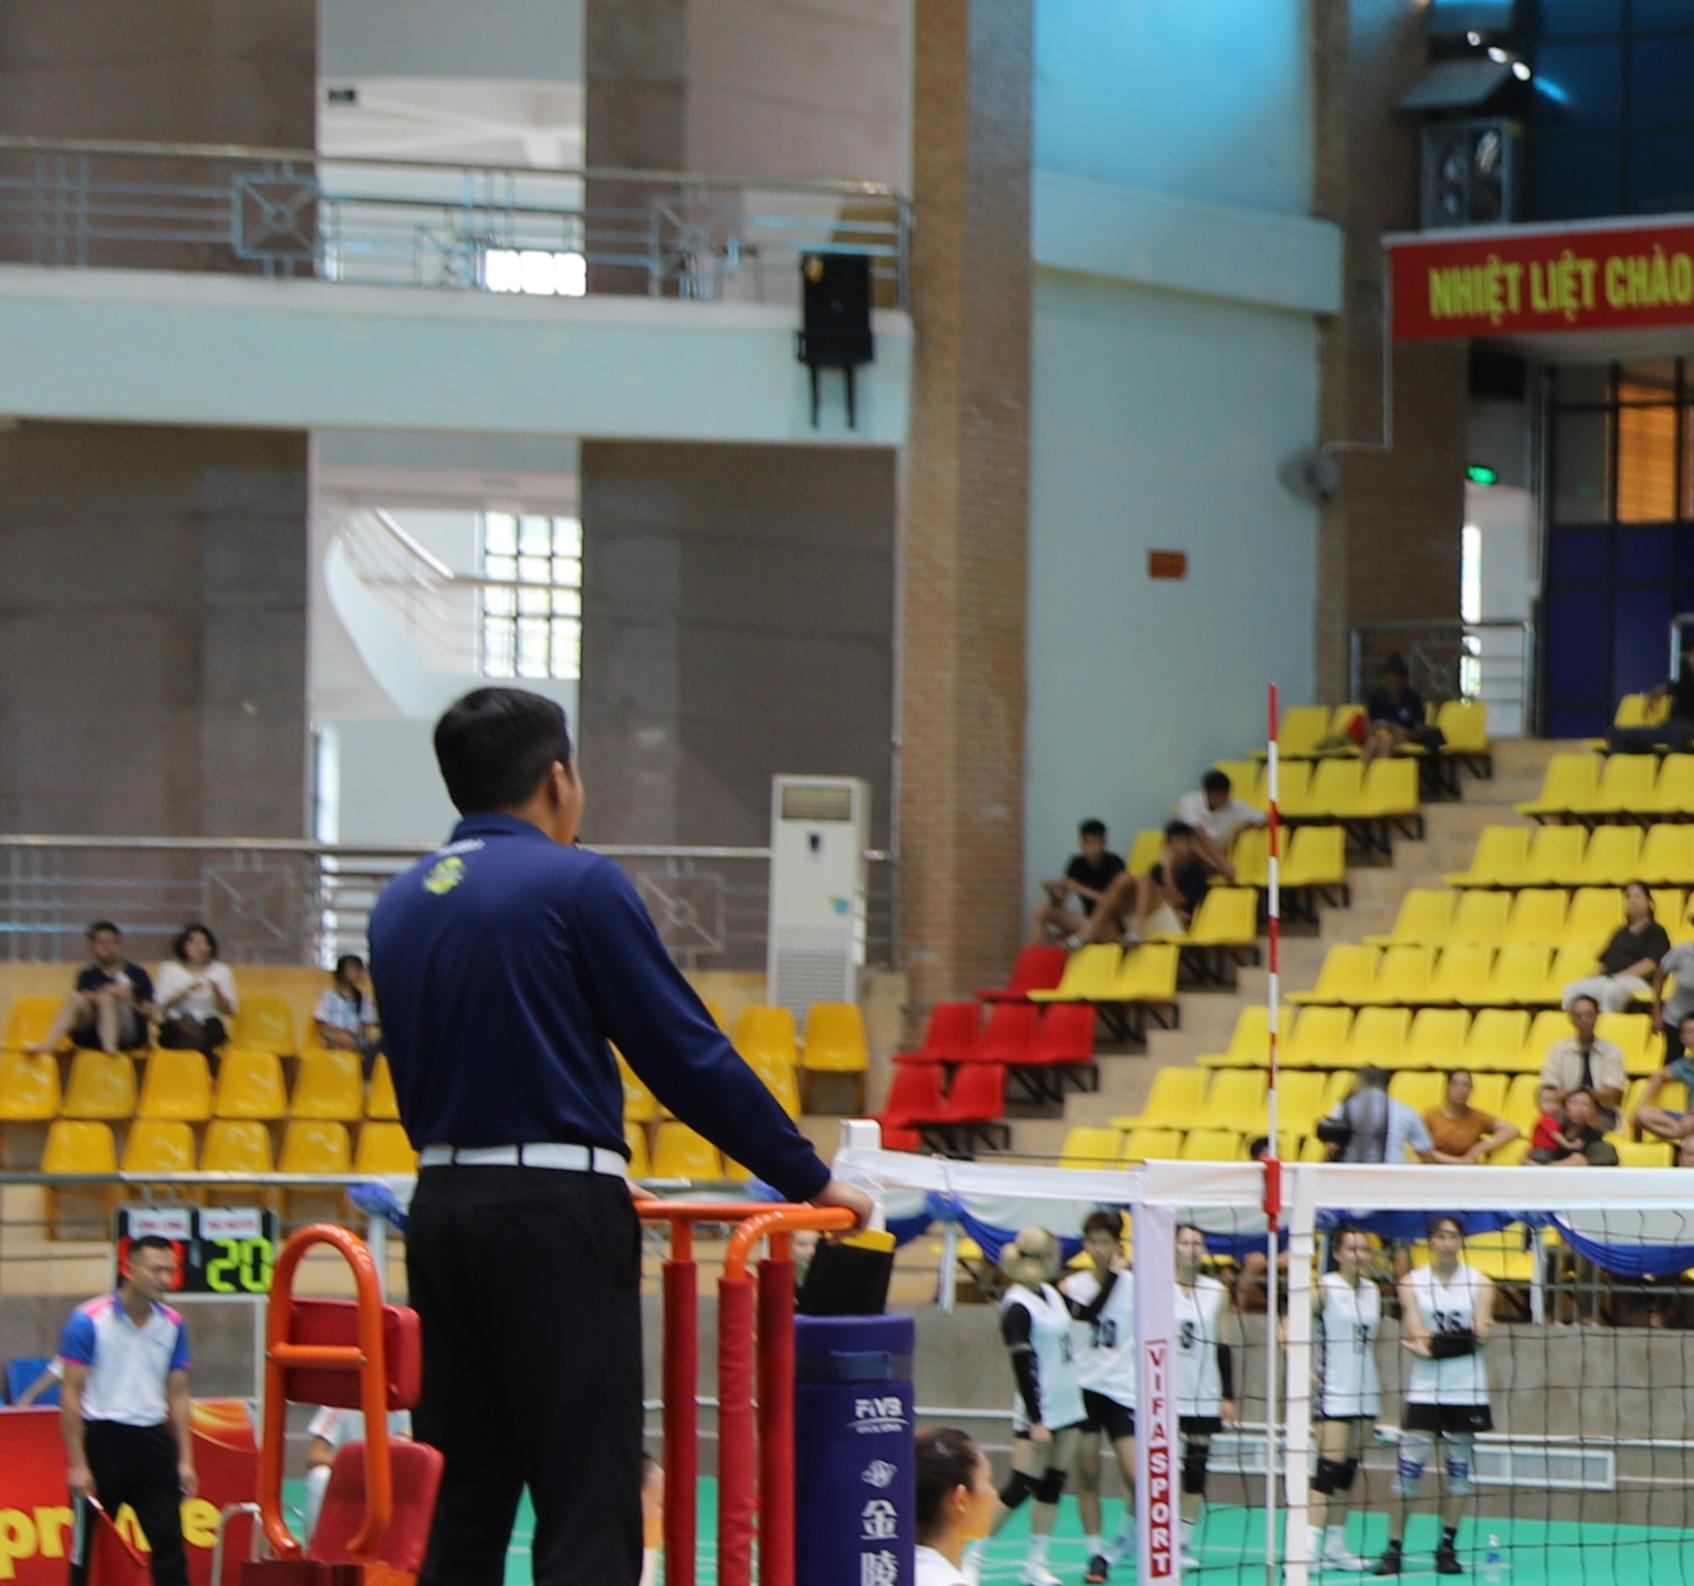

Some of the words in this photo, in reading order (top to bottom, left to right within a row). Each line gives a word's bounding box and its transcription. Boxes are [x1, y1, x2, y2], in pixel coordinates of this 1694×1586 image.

[1429, 253, 1522, 327] NHIỆT
[1531, 251, 1596, 322] LIỆT
[1605, 245, 1694, 307] CHÀO
[206, 1237, 275, 1293] 20
